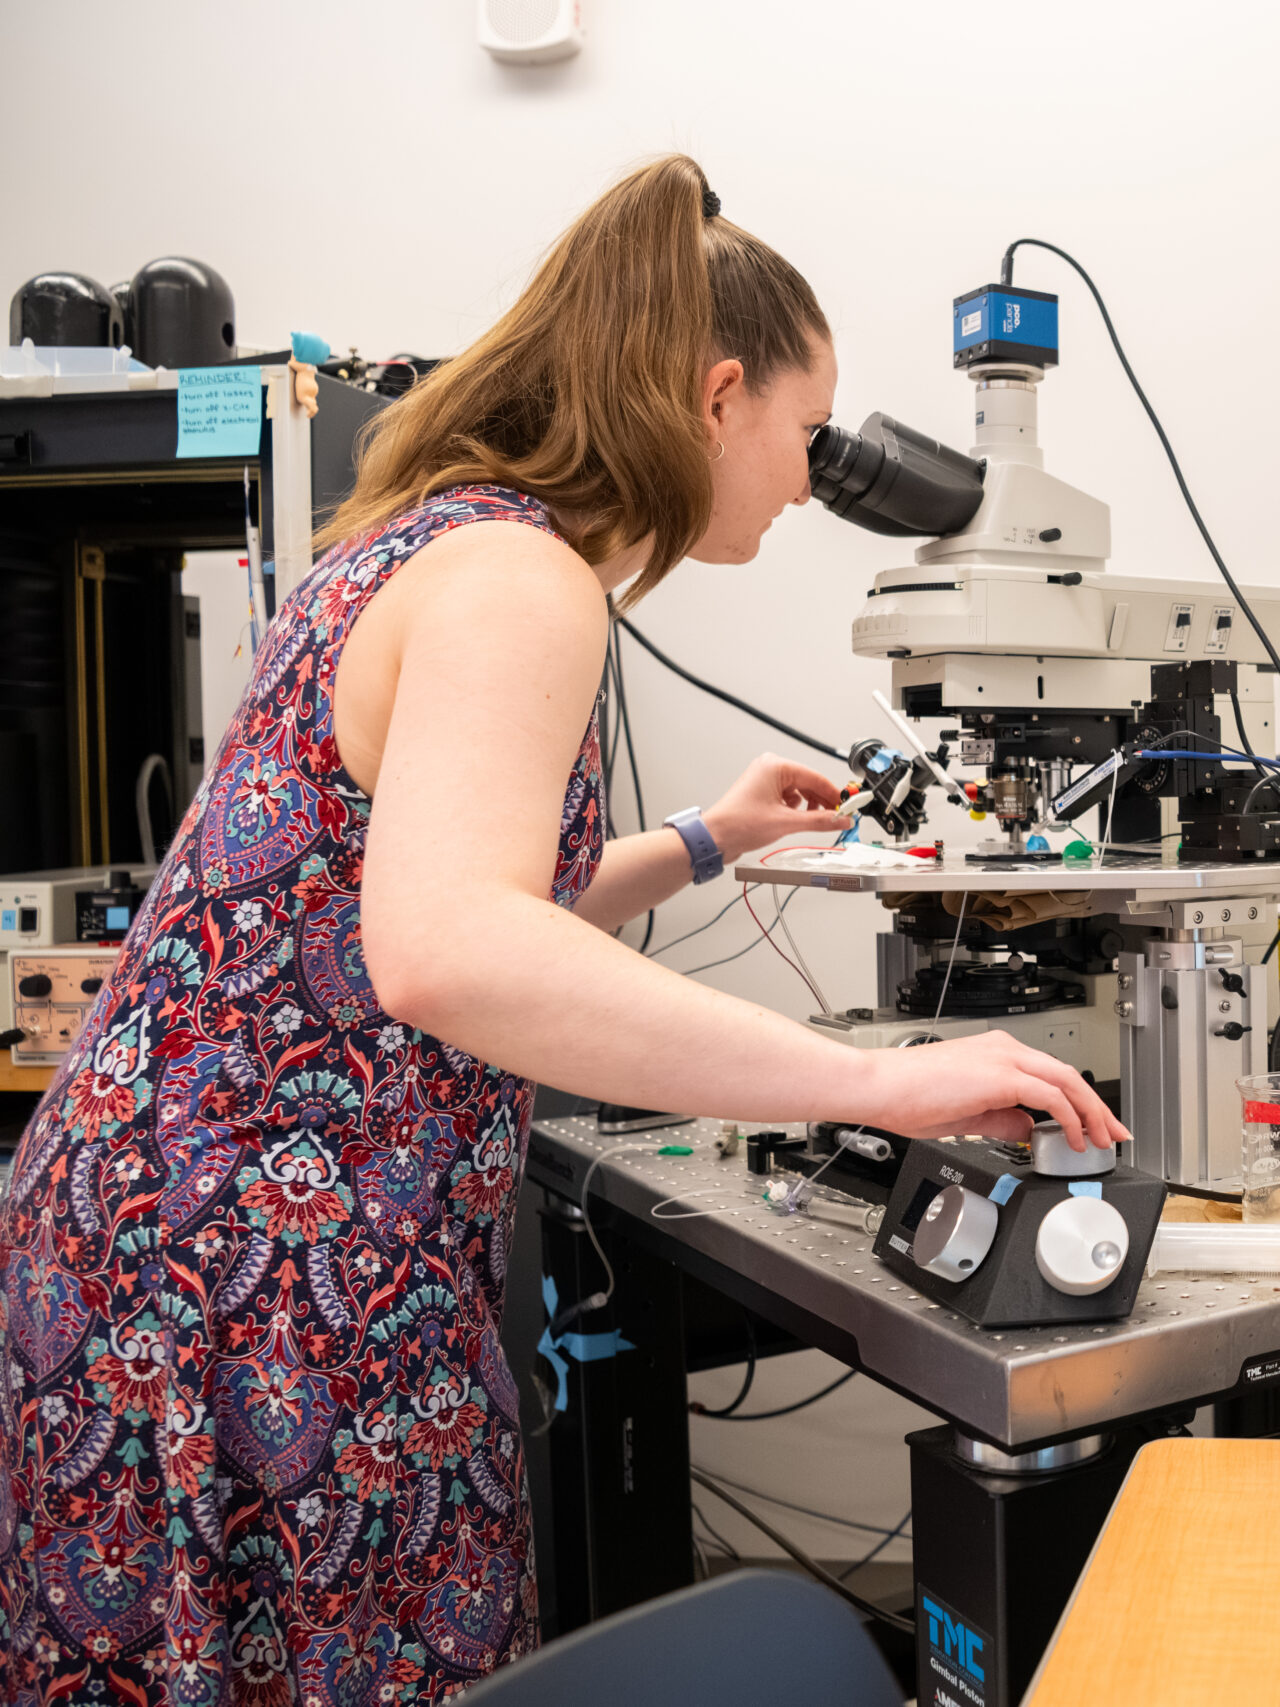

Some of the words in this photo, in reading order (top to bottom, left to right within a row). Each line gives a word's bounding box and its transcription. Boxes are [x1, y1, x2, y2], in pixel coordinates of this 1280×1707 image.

[939, 1165, 964, 1184] ROE-200
[1246, 1366, 1262, 1378] TMC
[923, 1595, 984, 1683] TMC
[930, 1657, 958, 1687] Gimbal
[959, 1679, 985, 1707] Piston
